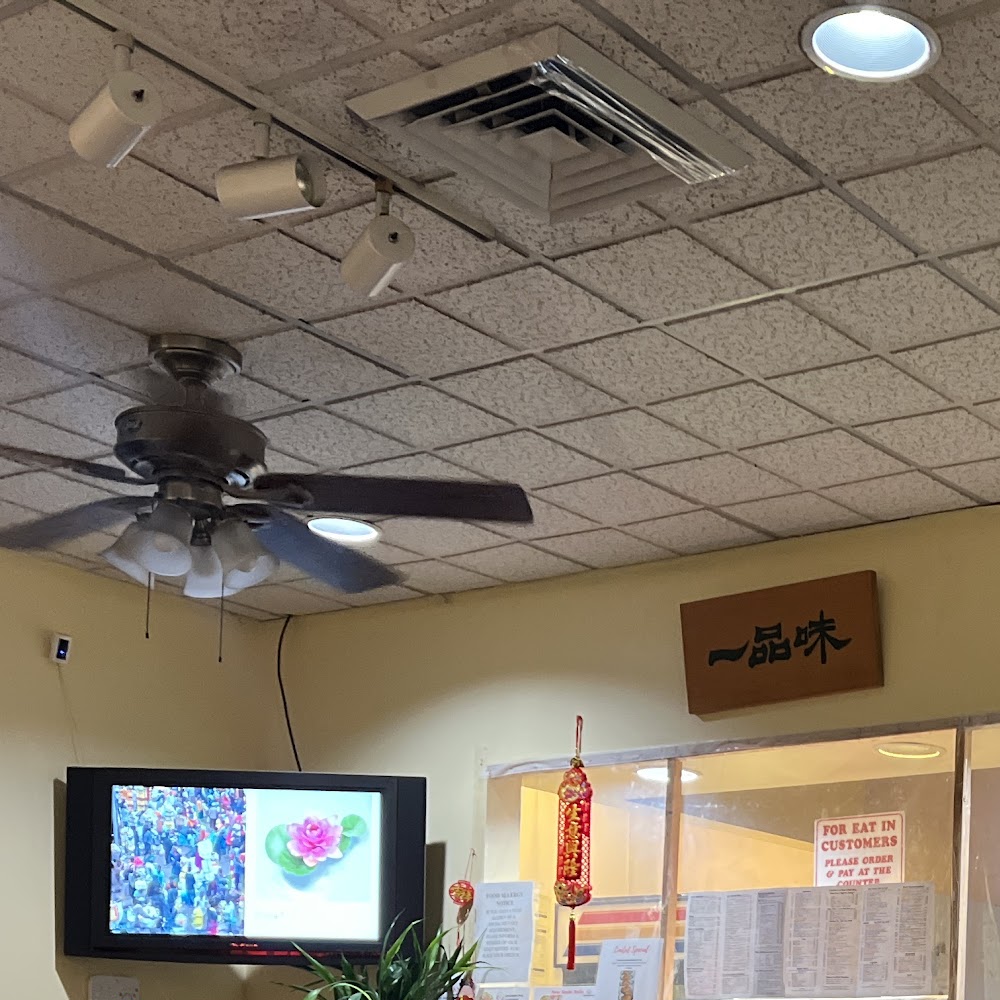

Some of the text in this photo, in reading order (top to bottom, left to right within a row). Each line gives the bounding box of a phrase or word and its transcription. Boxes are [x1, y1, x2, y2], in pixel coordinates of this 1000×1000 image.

[708, 610, 852, 668] 一品味
[822, 820, 896, 836] FOR EAT IN
[822, 836, 898, 852] CUSTOMERS
[825, 854, 894, 867] PLEASE ORDER
[838, 869, 854, 878] PAY
[858, 868, 870, 876] AT
[873, 866, 892, 874] THE
